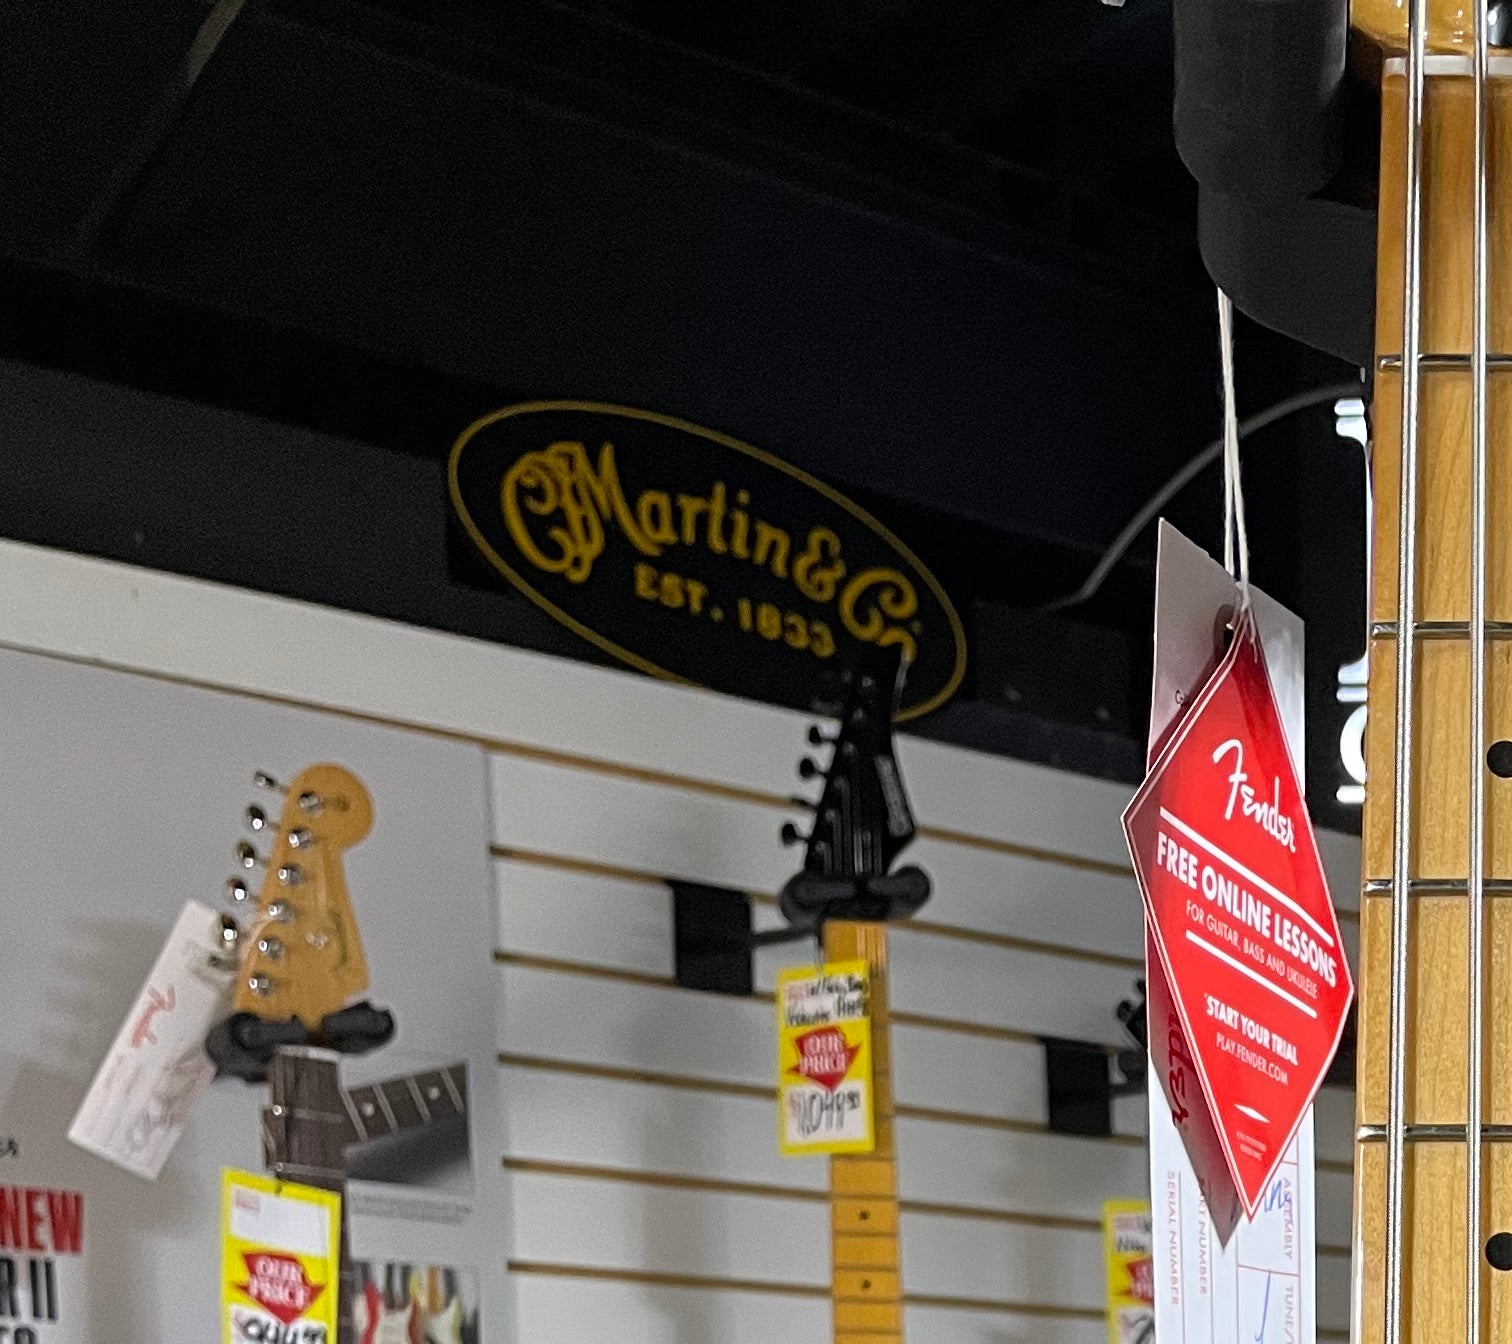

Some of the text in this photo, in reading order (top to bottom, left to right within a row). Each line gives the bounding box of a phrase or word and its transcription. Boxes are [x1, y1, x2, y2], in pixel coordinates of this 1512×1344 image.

[634, 562, 724, 616] EST.
[1212, 739, 1296, 853] Fender
[1157, 831, 1337, 988] FREE ONLINE LESSONS
[1186, 899, 1318, 999] FOR GUITAR, BASS AND UKULELE
[1216, 1032, 1289, 1086] PLAY.FENDER.COM
[1240, 1015, 1271, 1048] YOUR
[1271, 1032, 1299, 1067] TRIAL
[1167, 1169, 1180, 1306] SERIAL NUMBER
[1197, 1219, 1208, 1295] NUMBER
